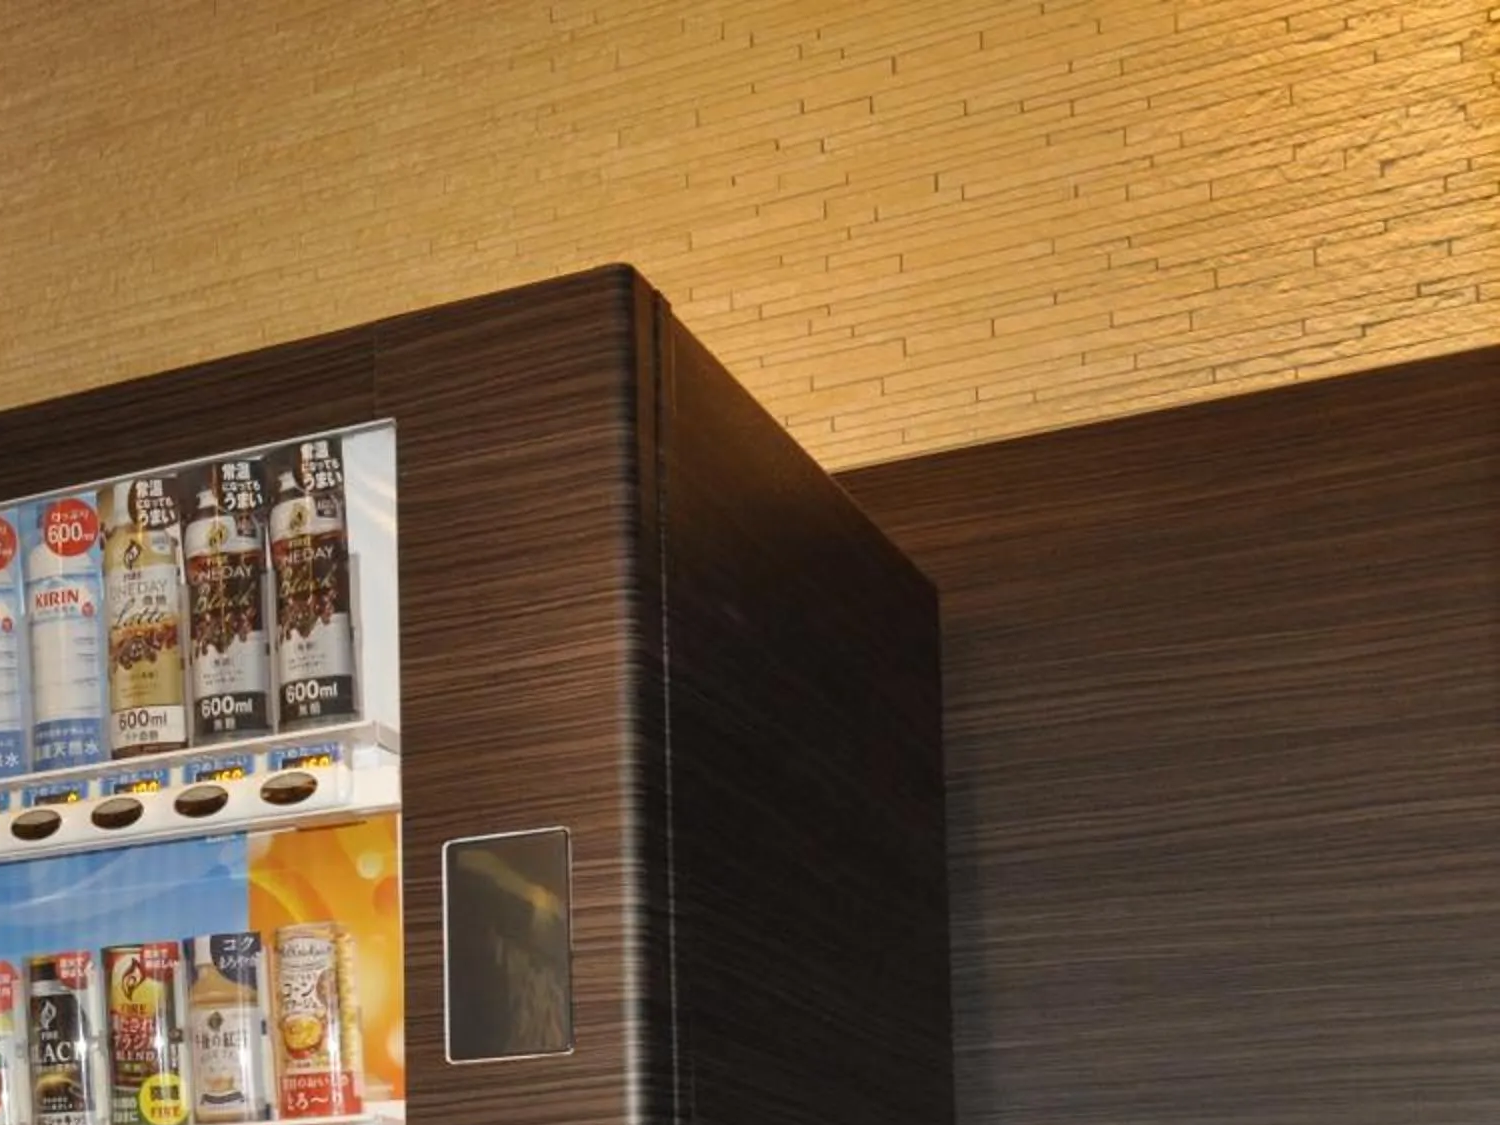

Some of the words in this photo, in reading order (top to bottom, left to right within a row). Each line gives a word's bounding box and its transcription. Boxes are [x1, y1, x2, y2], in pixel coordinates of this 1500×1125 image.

[301, 441, 328, 460] 常温
[222, 463, 250, 481] 常温
[304, 472, 343, 490] うまい
[136, 479, 163, 497] 常温
[223, 492, 263, 511] うまい
[137, 510, 177, 527] うまい
[35, 589, 79, 608] KIRIN
[285, 680, 338, 702] 600ml
[200, 695, 252, 717] 600ml
[118, 711, 167, 730] 600ml
[223, 937, 254, 951] コク
